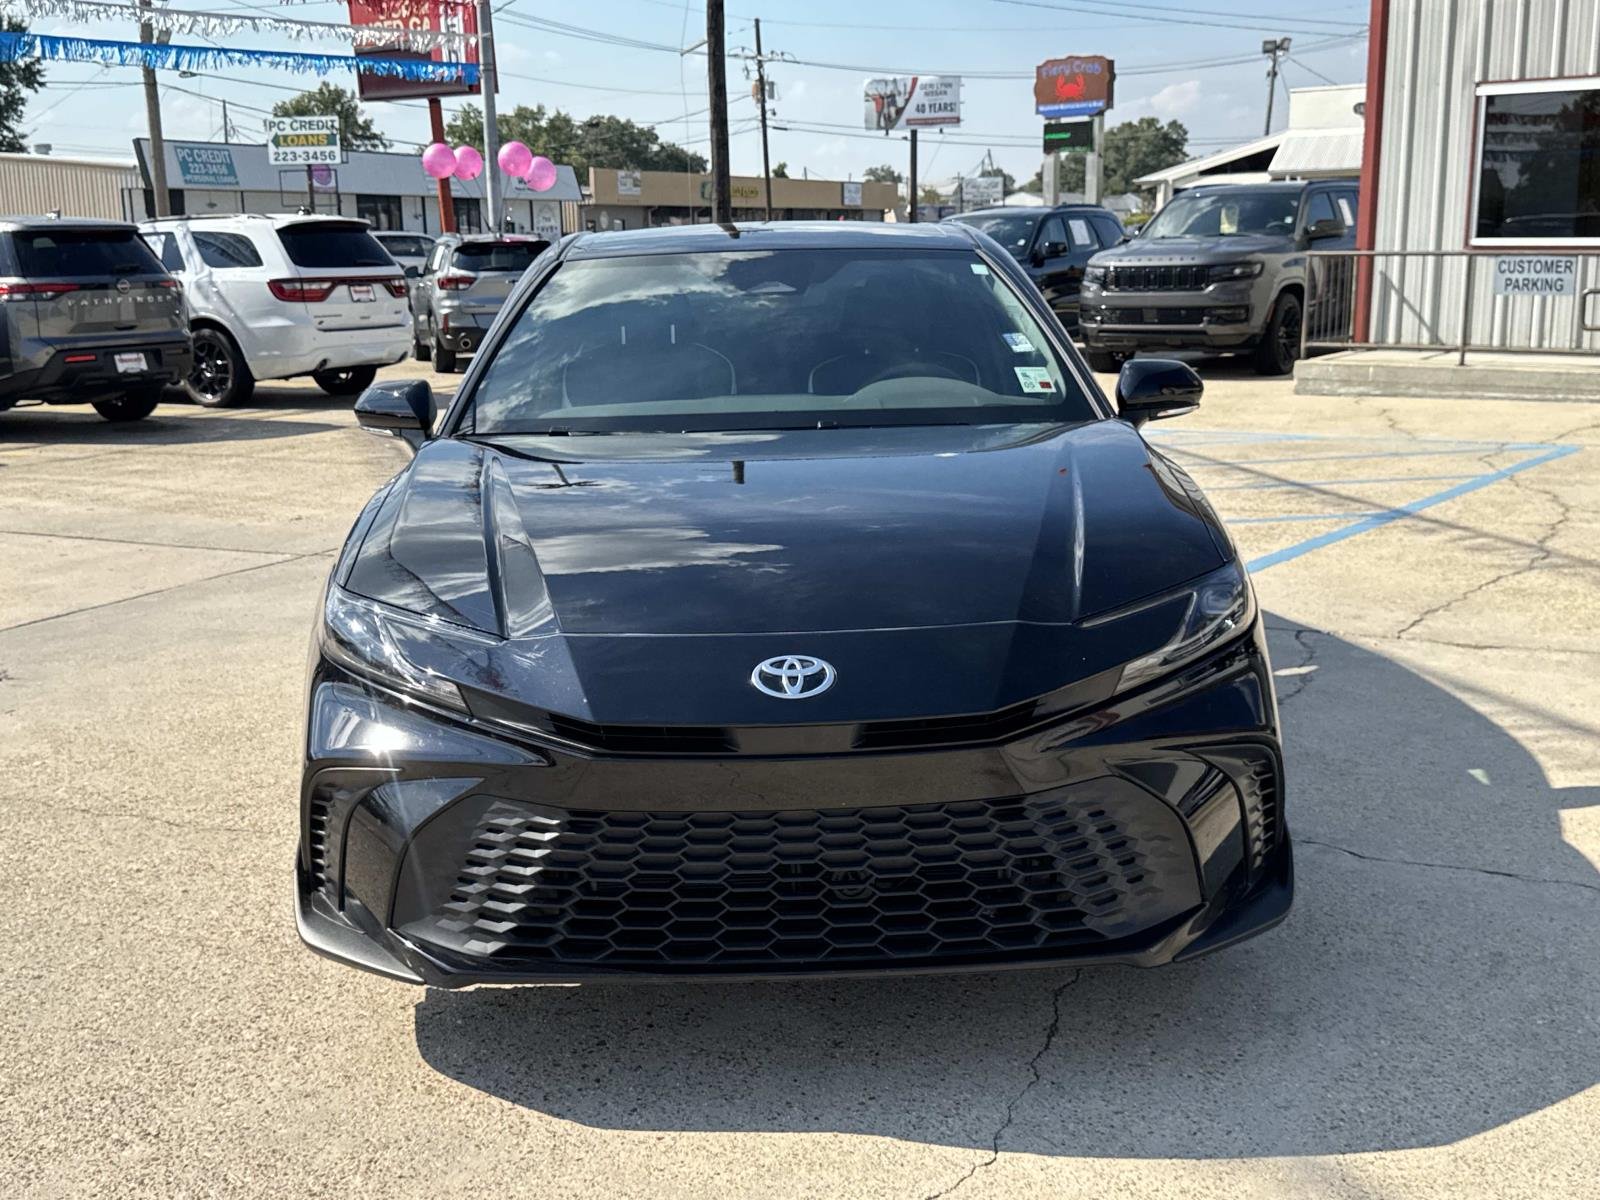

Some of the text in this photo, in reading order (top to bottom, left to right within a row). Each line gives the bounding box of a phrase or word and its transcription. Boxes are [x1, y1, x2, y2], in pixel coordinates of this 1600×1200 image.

[915, 102, 957, 113] 40 YEARS!
[269, 119, 336, 131] PC CREDIT
[280, 134, 328, 146] LOANS
[177, 148, 231, 164] PC CREDIT
[274, 151, 337, 162] 223-3456
[1498, 259, 1574, 274] CUSTOMER
[1504, 278, 1564, 292] PARKING
